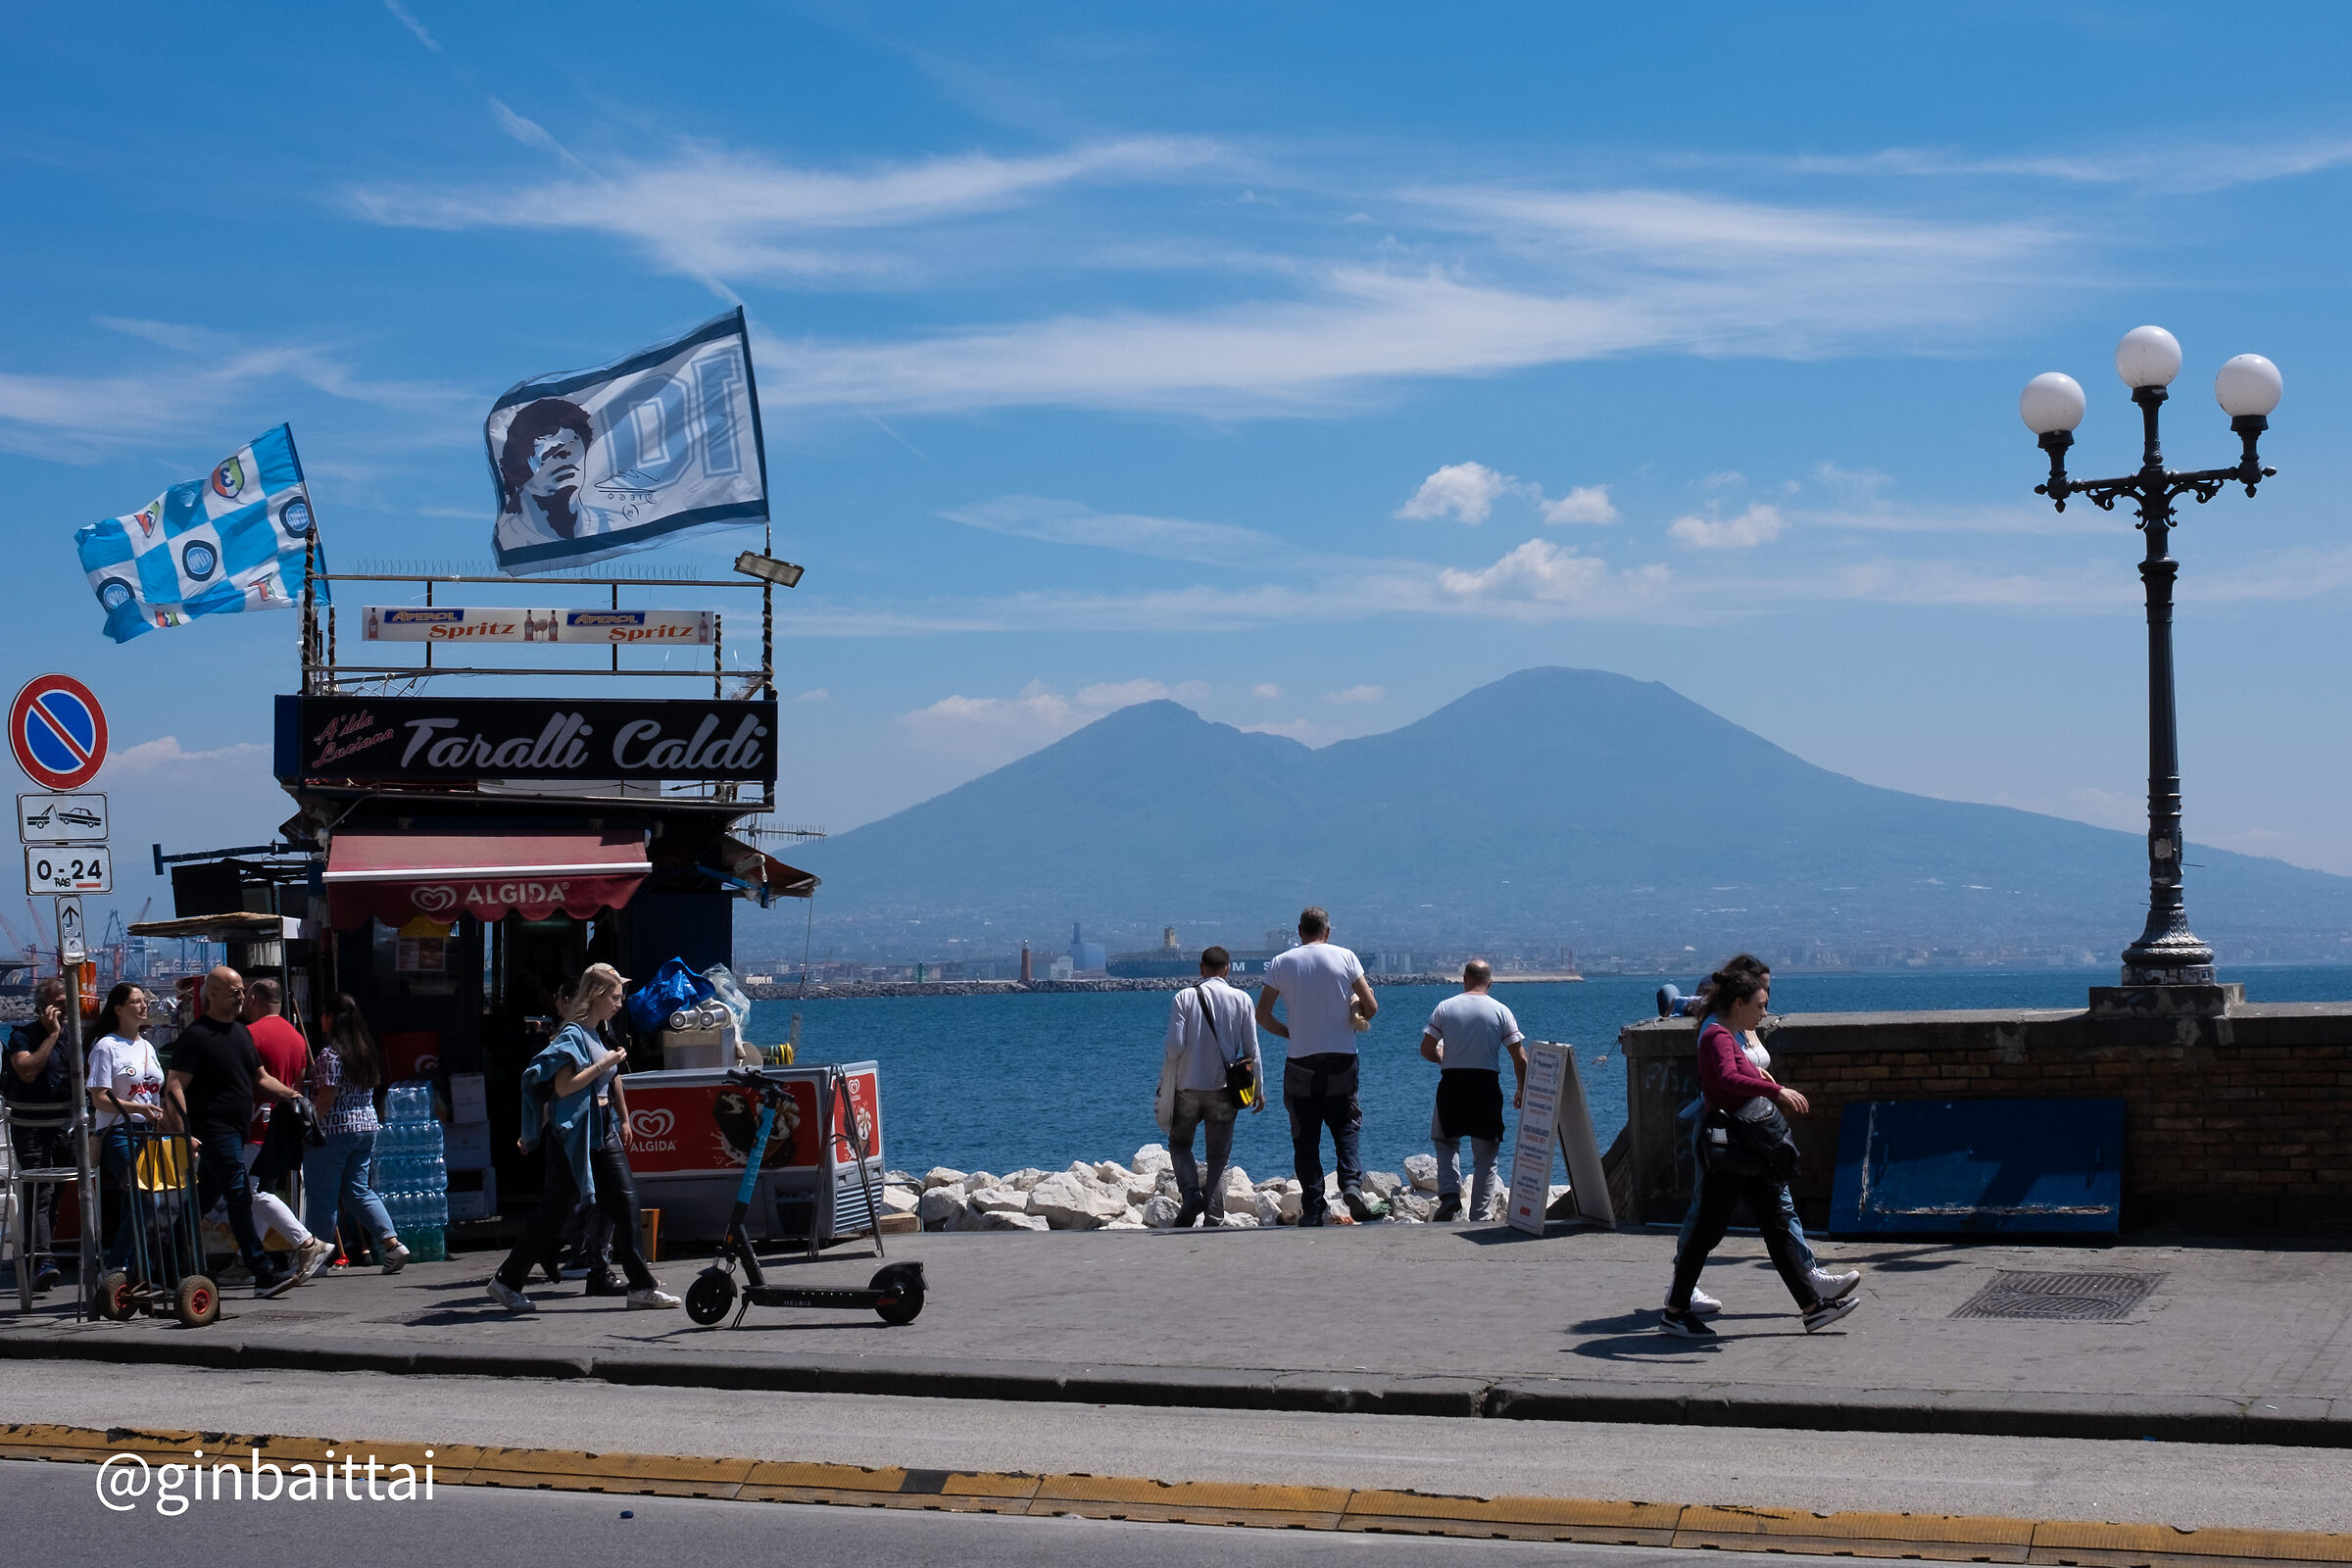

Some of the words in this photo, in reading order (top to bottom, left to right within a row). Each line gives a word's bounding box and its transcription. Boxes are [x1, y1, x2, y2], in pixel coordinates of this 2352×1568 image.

[392, 612, 458, 622] APEROL
[574, 612, 639, 624] APEROL
[428, 622, 515, 640] Spritz
[608, 624, 694, 642] Spritz
[401, 711, 594, 769] Taralli
[612, 712, 768, 769] Caldi
[465, 882, 566, 905] ALGIDA
[629, 1140, 676, 1153] ALGIDA
